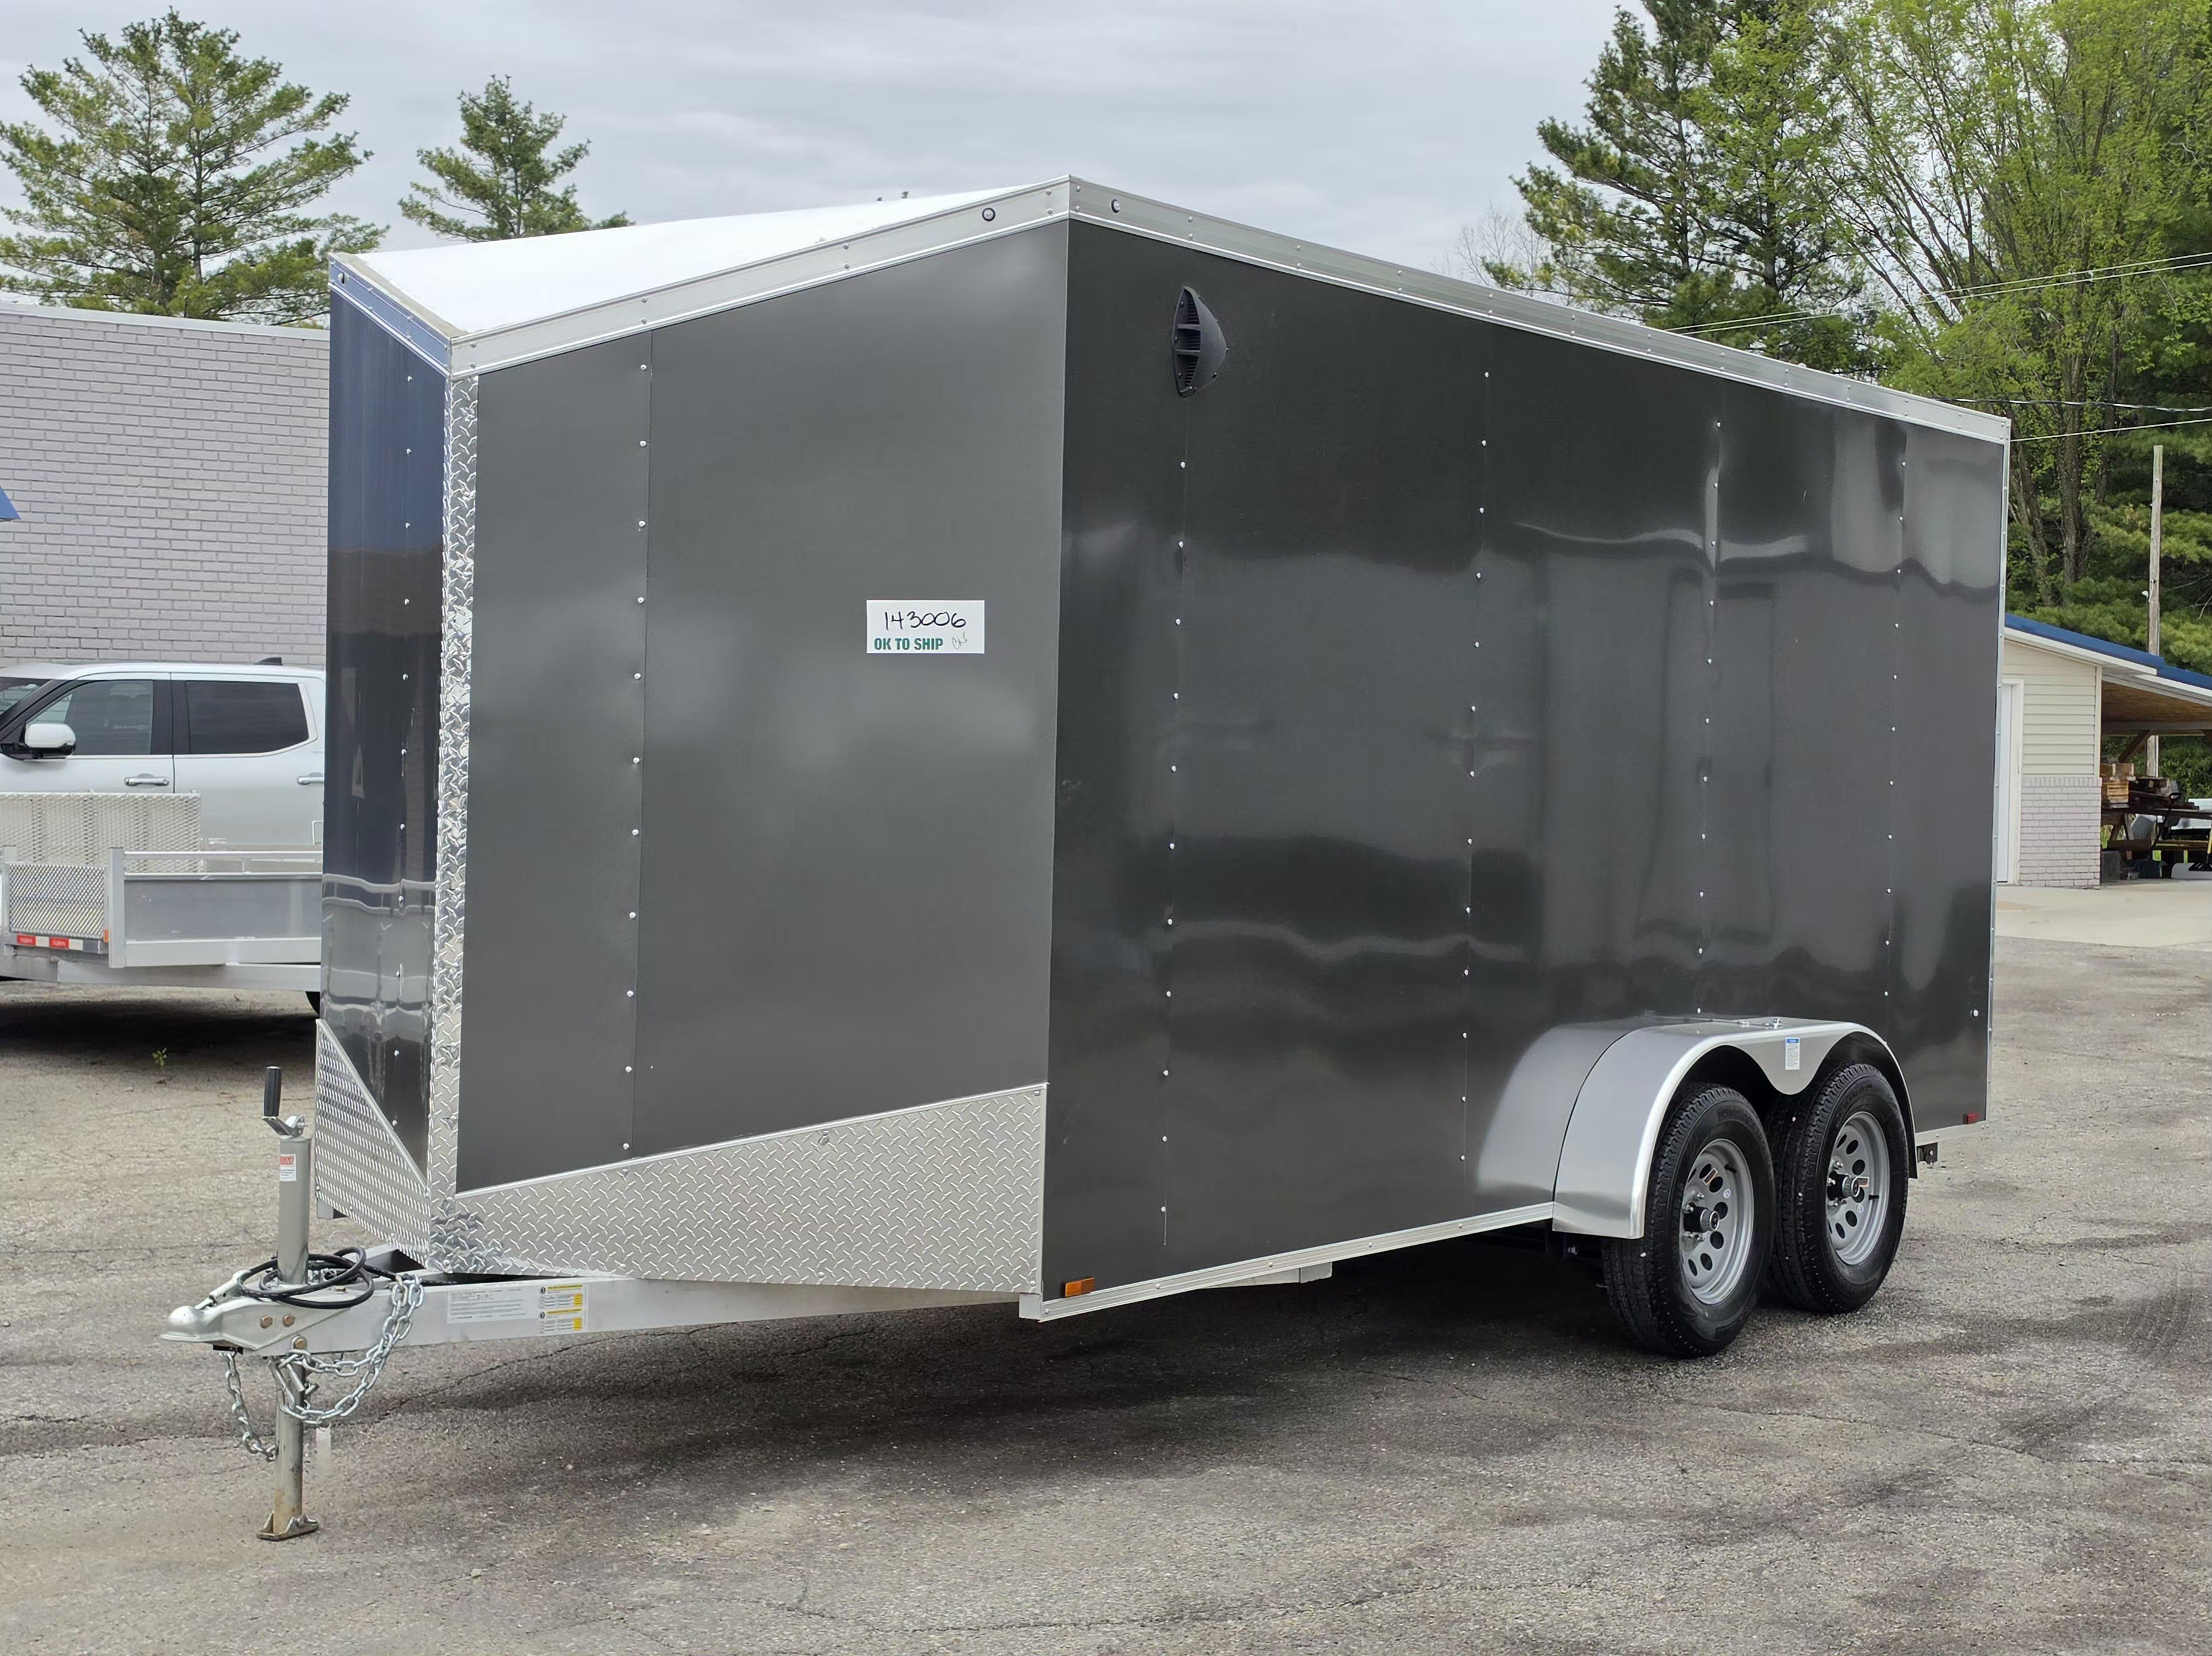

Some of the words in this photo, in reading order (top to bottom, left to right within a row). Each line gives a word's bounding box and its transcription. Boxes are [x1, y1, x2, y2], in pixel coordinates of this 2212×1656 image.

[884, 611, 966, 630] 143006
[874, 638, 891, 650] OK
[895, 638, 910, 650] TO
[914, 638, 943, 650] SHIP
